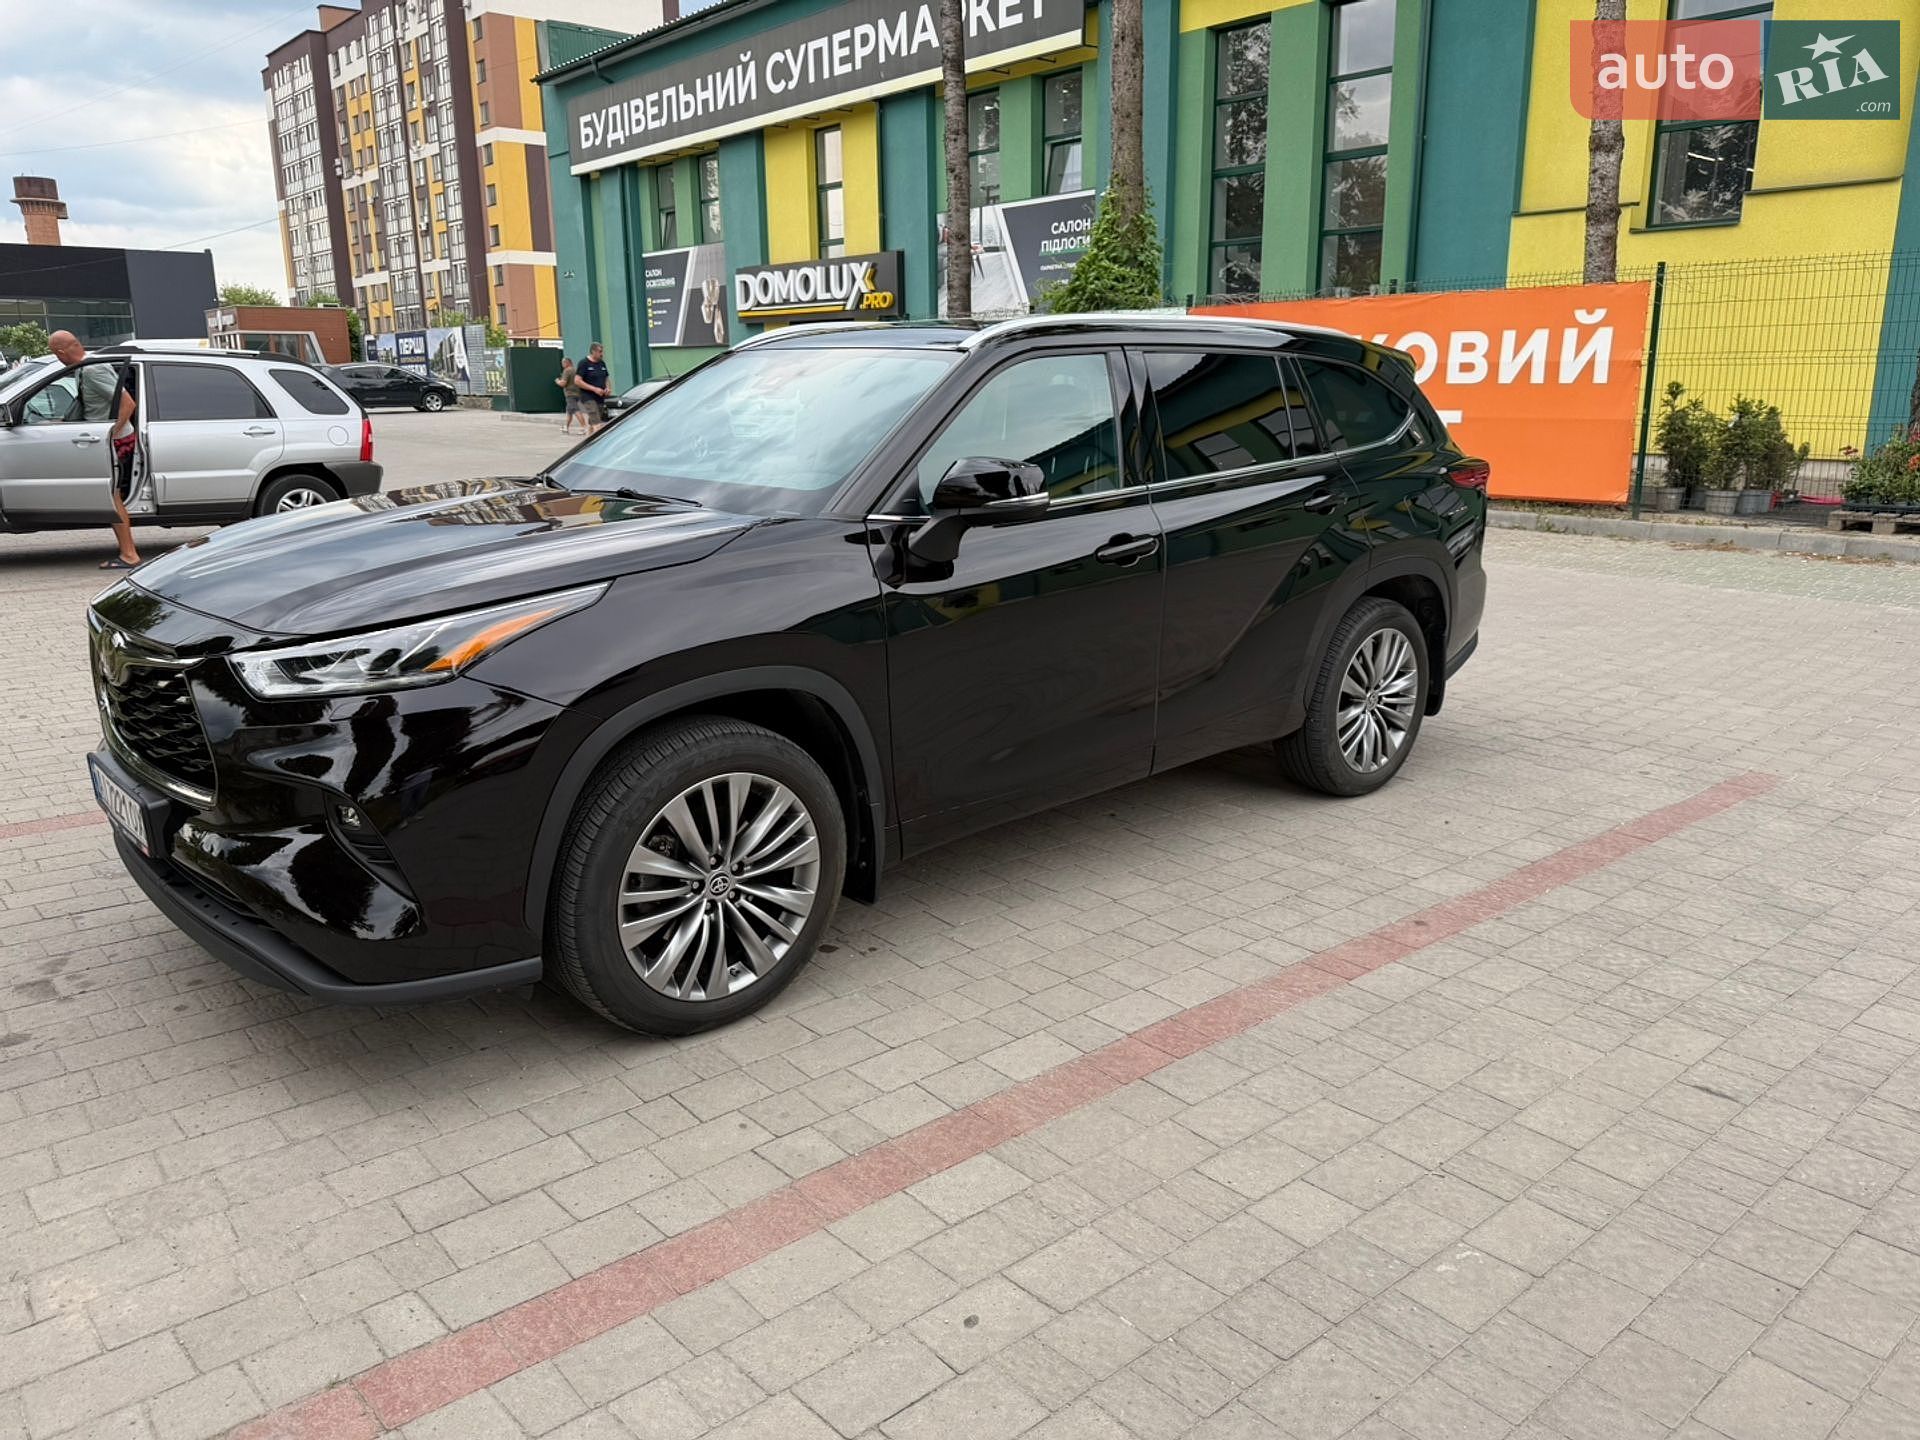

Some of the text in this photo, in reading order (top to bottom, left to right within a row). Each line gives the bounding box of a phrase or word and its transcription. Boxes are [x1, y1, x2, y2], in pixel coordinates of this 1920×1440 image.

[579, 50, 757, 149] БУДІВЕЛЬНИЙ
[1051, 218, 1091, 235] САЛОН
[734, 261, 873, 312] DOMOLUX
